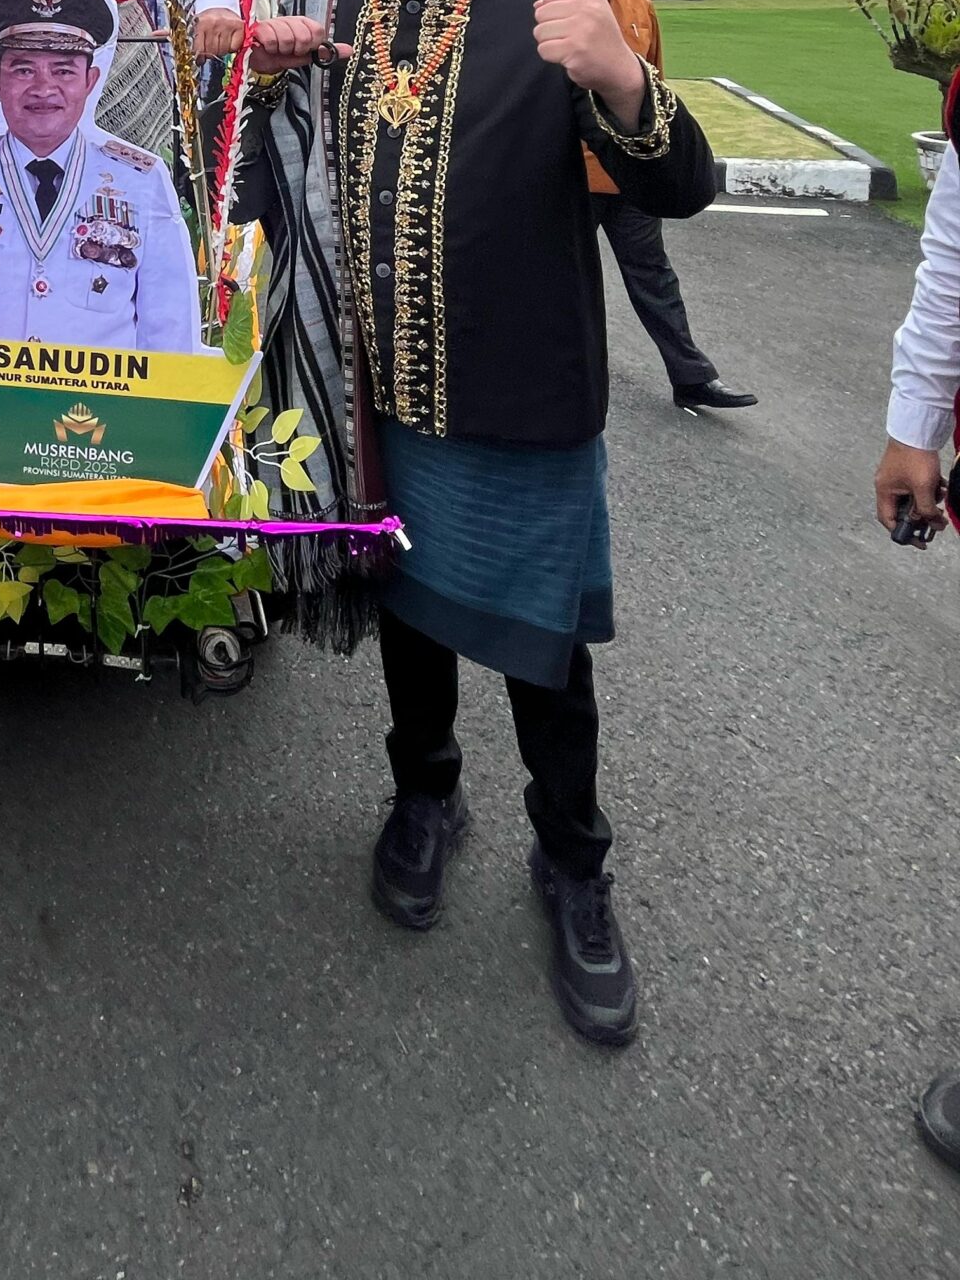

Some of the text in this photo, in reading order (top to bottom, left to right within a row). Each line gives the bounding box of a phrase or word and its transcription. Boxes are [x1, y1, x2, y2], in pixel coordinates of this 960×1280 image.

[25, 374, 87, 388] SUMATERA
[91, 380, 130, 392] UTARA
[24, 442, 134, 464] MUSRENBANG
[23, 466, 60, 477] PROVINSI
[62, 469, 104, 480] SUMATERA
[40, 457, 117, 474] RKPD 2025
